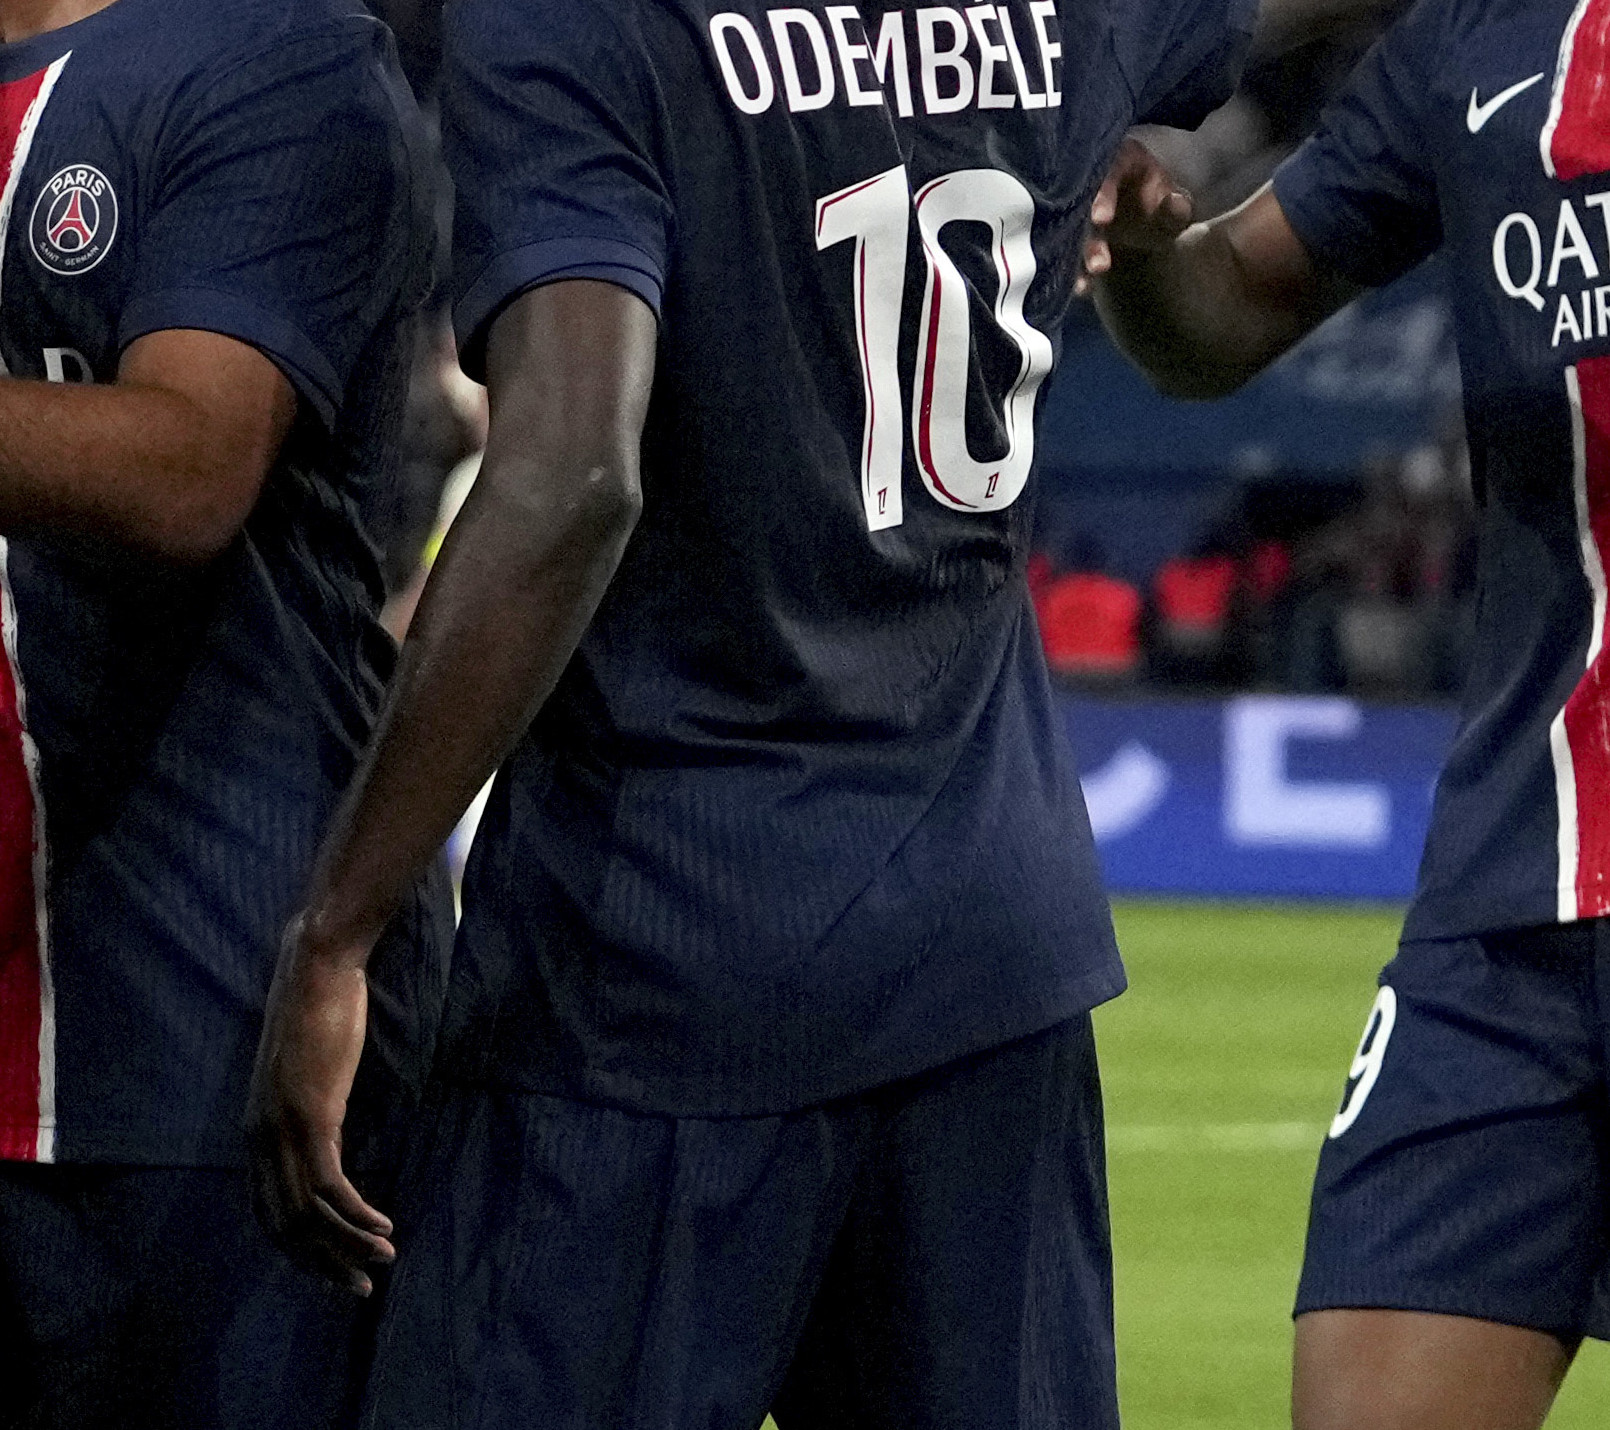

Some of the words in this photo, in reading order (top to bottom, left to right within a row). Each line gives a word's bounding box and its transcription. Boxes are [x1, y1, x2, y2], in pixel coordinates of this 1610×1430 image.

[50, 169, 106, 197] PARIS
[815, 164, 1053, 532] 10
[1329, 985, 1398, 1139] 9
